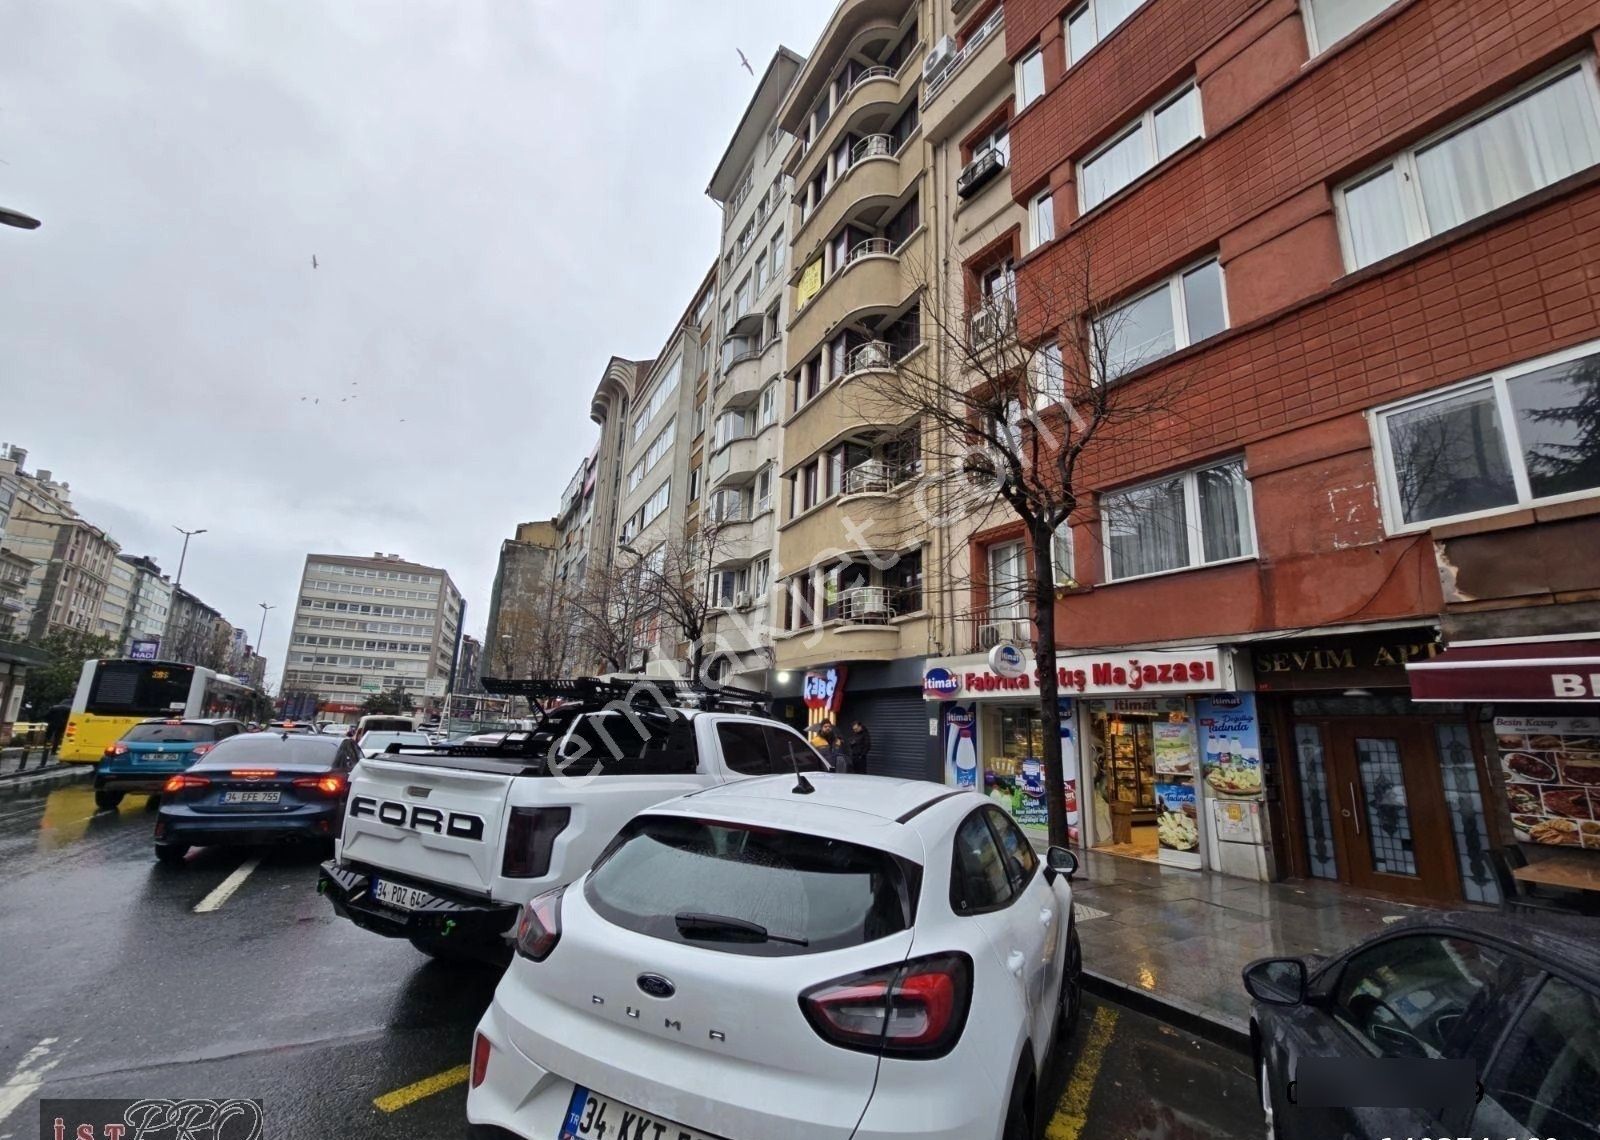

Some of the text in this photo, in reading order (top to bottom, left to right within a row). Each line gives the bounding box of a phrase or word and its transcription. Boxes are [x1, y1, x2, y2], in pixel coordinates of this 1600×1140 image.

[1034, 666, 1087, 692] tış
[1092, 659, 1214, 690] Mağazası
[226, 792, 279, 802] 34 EFE 755
[350, 796, 485, 841] FORD
[377, 881, 388, 899] 34
[592, 994, 726, 1042] PUMA
[570, 1111, 580, 1125] TR
[579, 1096, 608, 1140] 34
